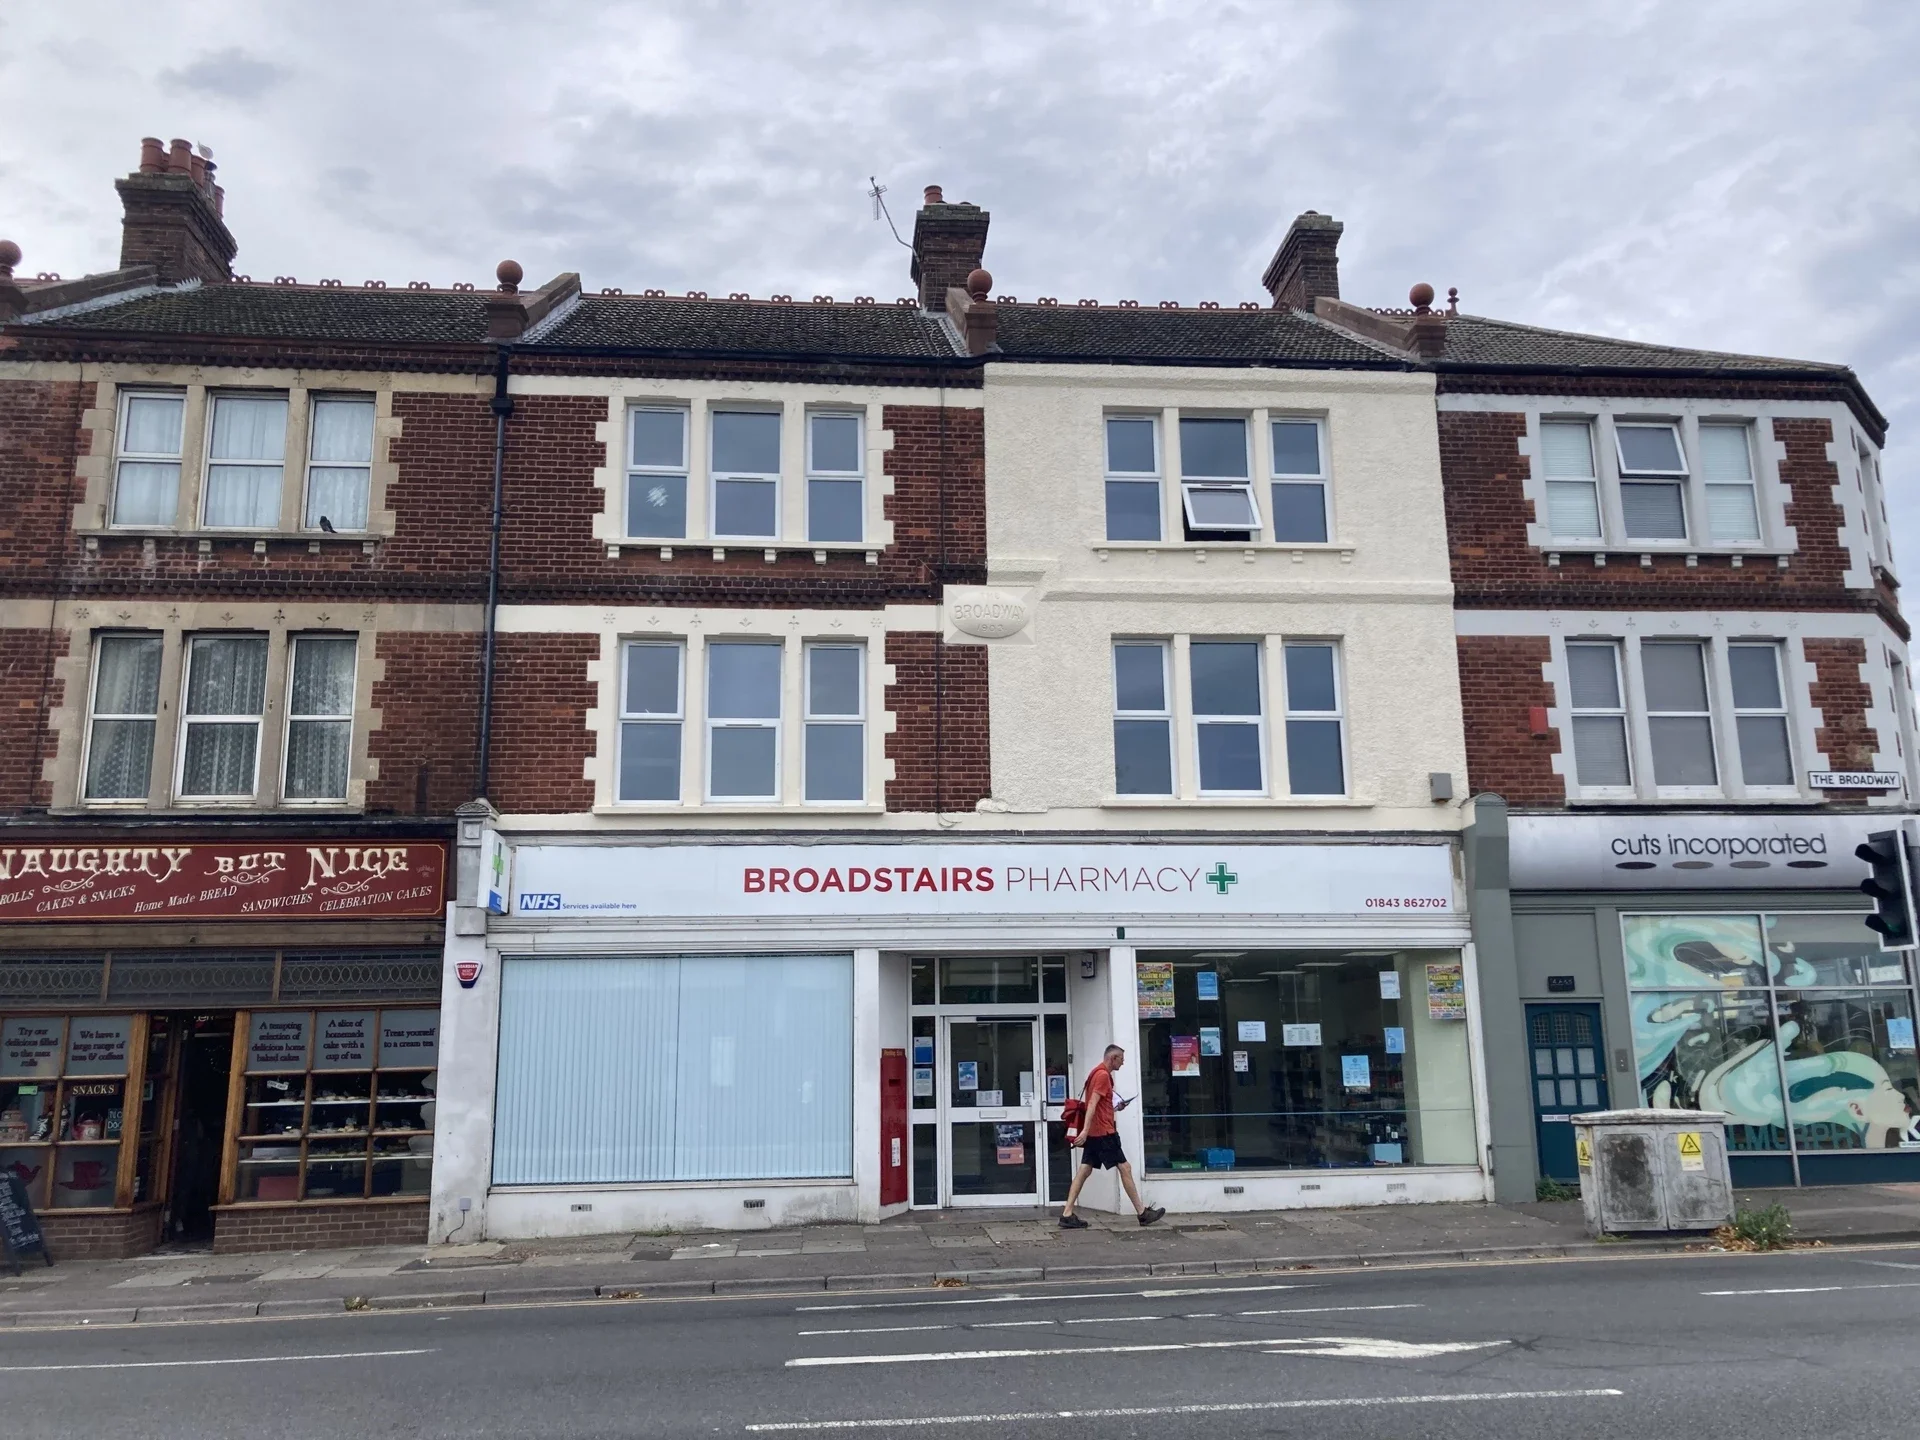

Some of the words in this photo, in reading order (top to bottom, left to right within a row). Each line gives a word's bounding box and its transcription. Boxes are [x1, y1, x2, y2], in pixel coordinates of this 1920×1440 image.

[954, 604, 1026, 620] BROADWAY
[1812, 774, 1834, 785] THE
[1839, 774, 1896, 785] BROADWAY
[1611, 834, 1661, 856] cuts
[1668, 833, 1827, 859] incorporated
[204, 852, 286, 876] BUT
[301, 847, 409, 890] NICE
[743, 866, 995, 893] BROADSTAIRS
[1006, 866, 1201, 892] PHARMACY
[0, 889, 35, 906] ROLLS
[36, 896, 75, 913] CAKES
[78, 893, 87, 905] &
[90, 884, 136, 903] SNACKS
[134, 900, 164, 914] Home
[167, 893, 196, 908] Made
[199, 885, 238, 902] BREAD
[319, 890, 394, 912] CELEBRATION
[396, 885, 433, 901] CAKES
[521, 894, 560, 910] NHS
[240, 893, 314, 913] SANDWICHES
[1365, 898, 1400, 908] 01843
[1403, 898, 1447, 908] 862702
[258, 1021, 267, 1029] A
[269, 1021, 302, 1031] tempting
[328, 1019, 336, 1027] A
[338, 1019, 353, 1027] slice
[355, 1018, 365, 1027] of
[18, 1027, 33, 1037] Try
[79, 1031, 94, 1039] We
[95, 1030, 114, 1038] have
[258, 1032, 291, 1040] selection
[292, 1032, 301, 1041] of
[325, 1030, 364, 1038] homemade
[384, 1029, 404, 1037] Treat
[406, 1028, 436, 1038] yourself
[73, 1042, 92, 1052] large
[93, 1044, 115, 1052] range
[116, 1041, 125, 1049] of
[252, 1043, 284, 1051] delicious
[285, 1043, 305, 1051] home
[323, 1041, 340, 1049] cake
[341, 1040, 359, 1049] with
[20, 1049, 33, 1057] the
[256, 1053, 279, 1062] baked
[280, 1053, 299, 1062] cakes
[325, 1053, 339, 1061] cup
[340, 1051, 350, 1060] of
[72, 1084, 115, 1095] SNACKS
